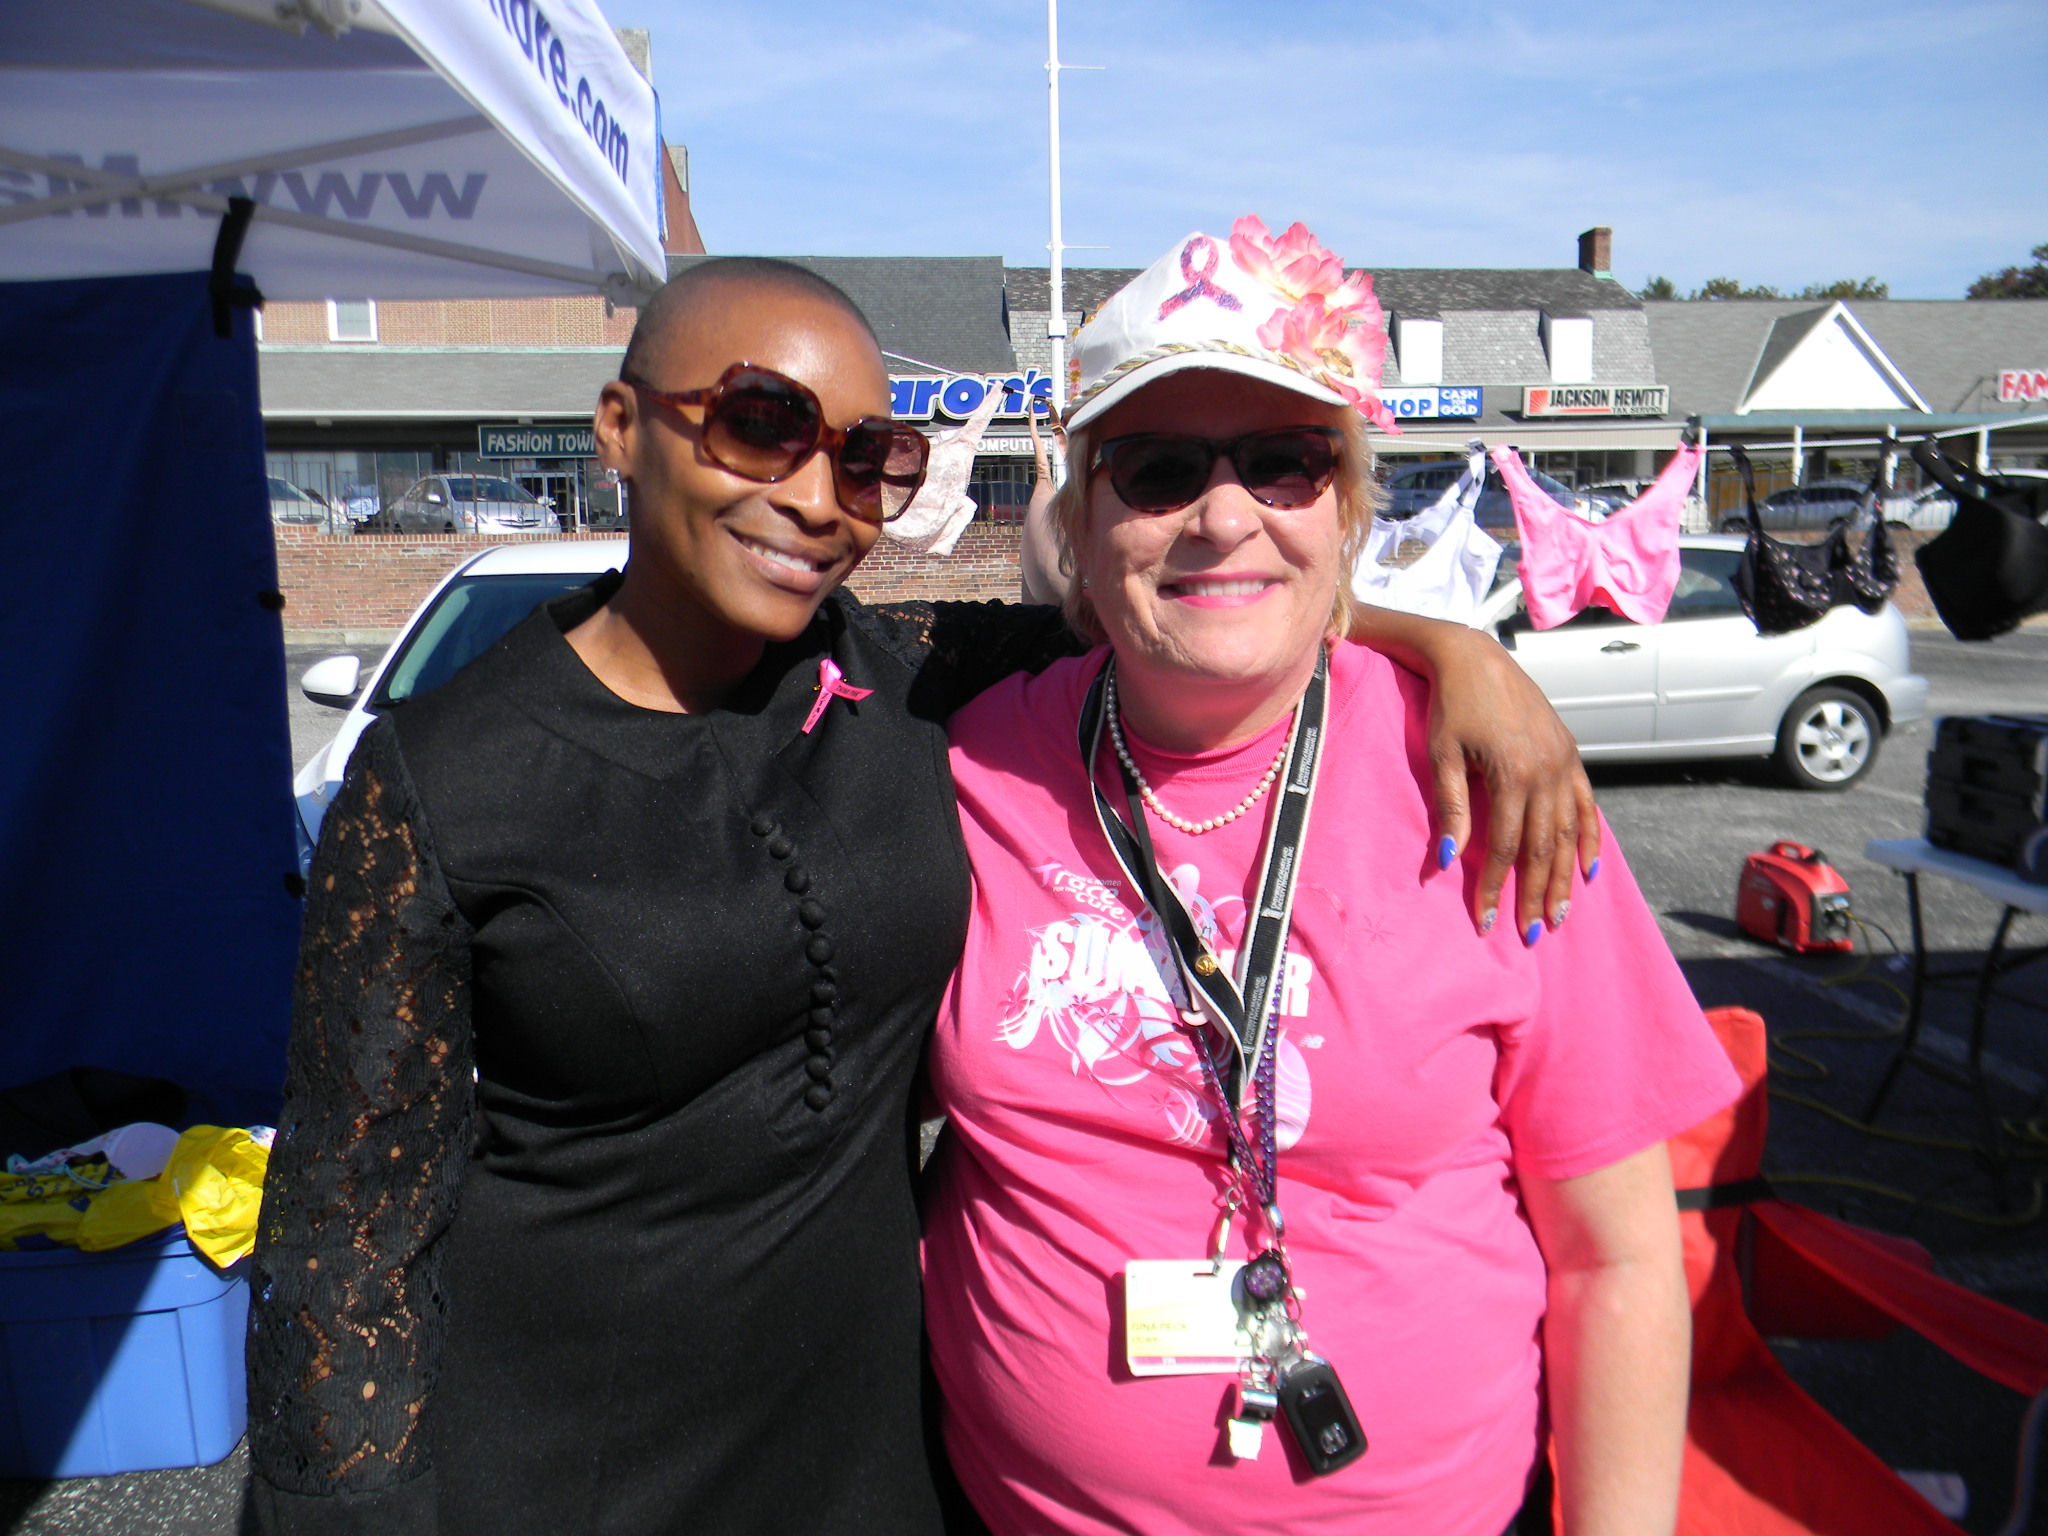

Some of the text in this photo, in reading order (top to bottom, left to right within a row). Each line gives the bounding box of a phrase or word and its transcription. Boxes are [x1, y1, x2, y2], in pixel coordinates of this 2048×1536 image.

[1441, 389, 1478, 400] CASH
[1549, 388, 1665, 407] JACKSON HEWITT
[1440, 405, 1478, 416] GOLD
[1630, 406, 1664, 414] SERVICE
[1054, 870, 1119, 905] race
